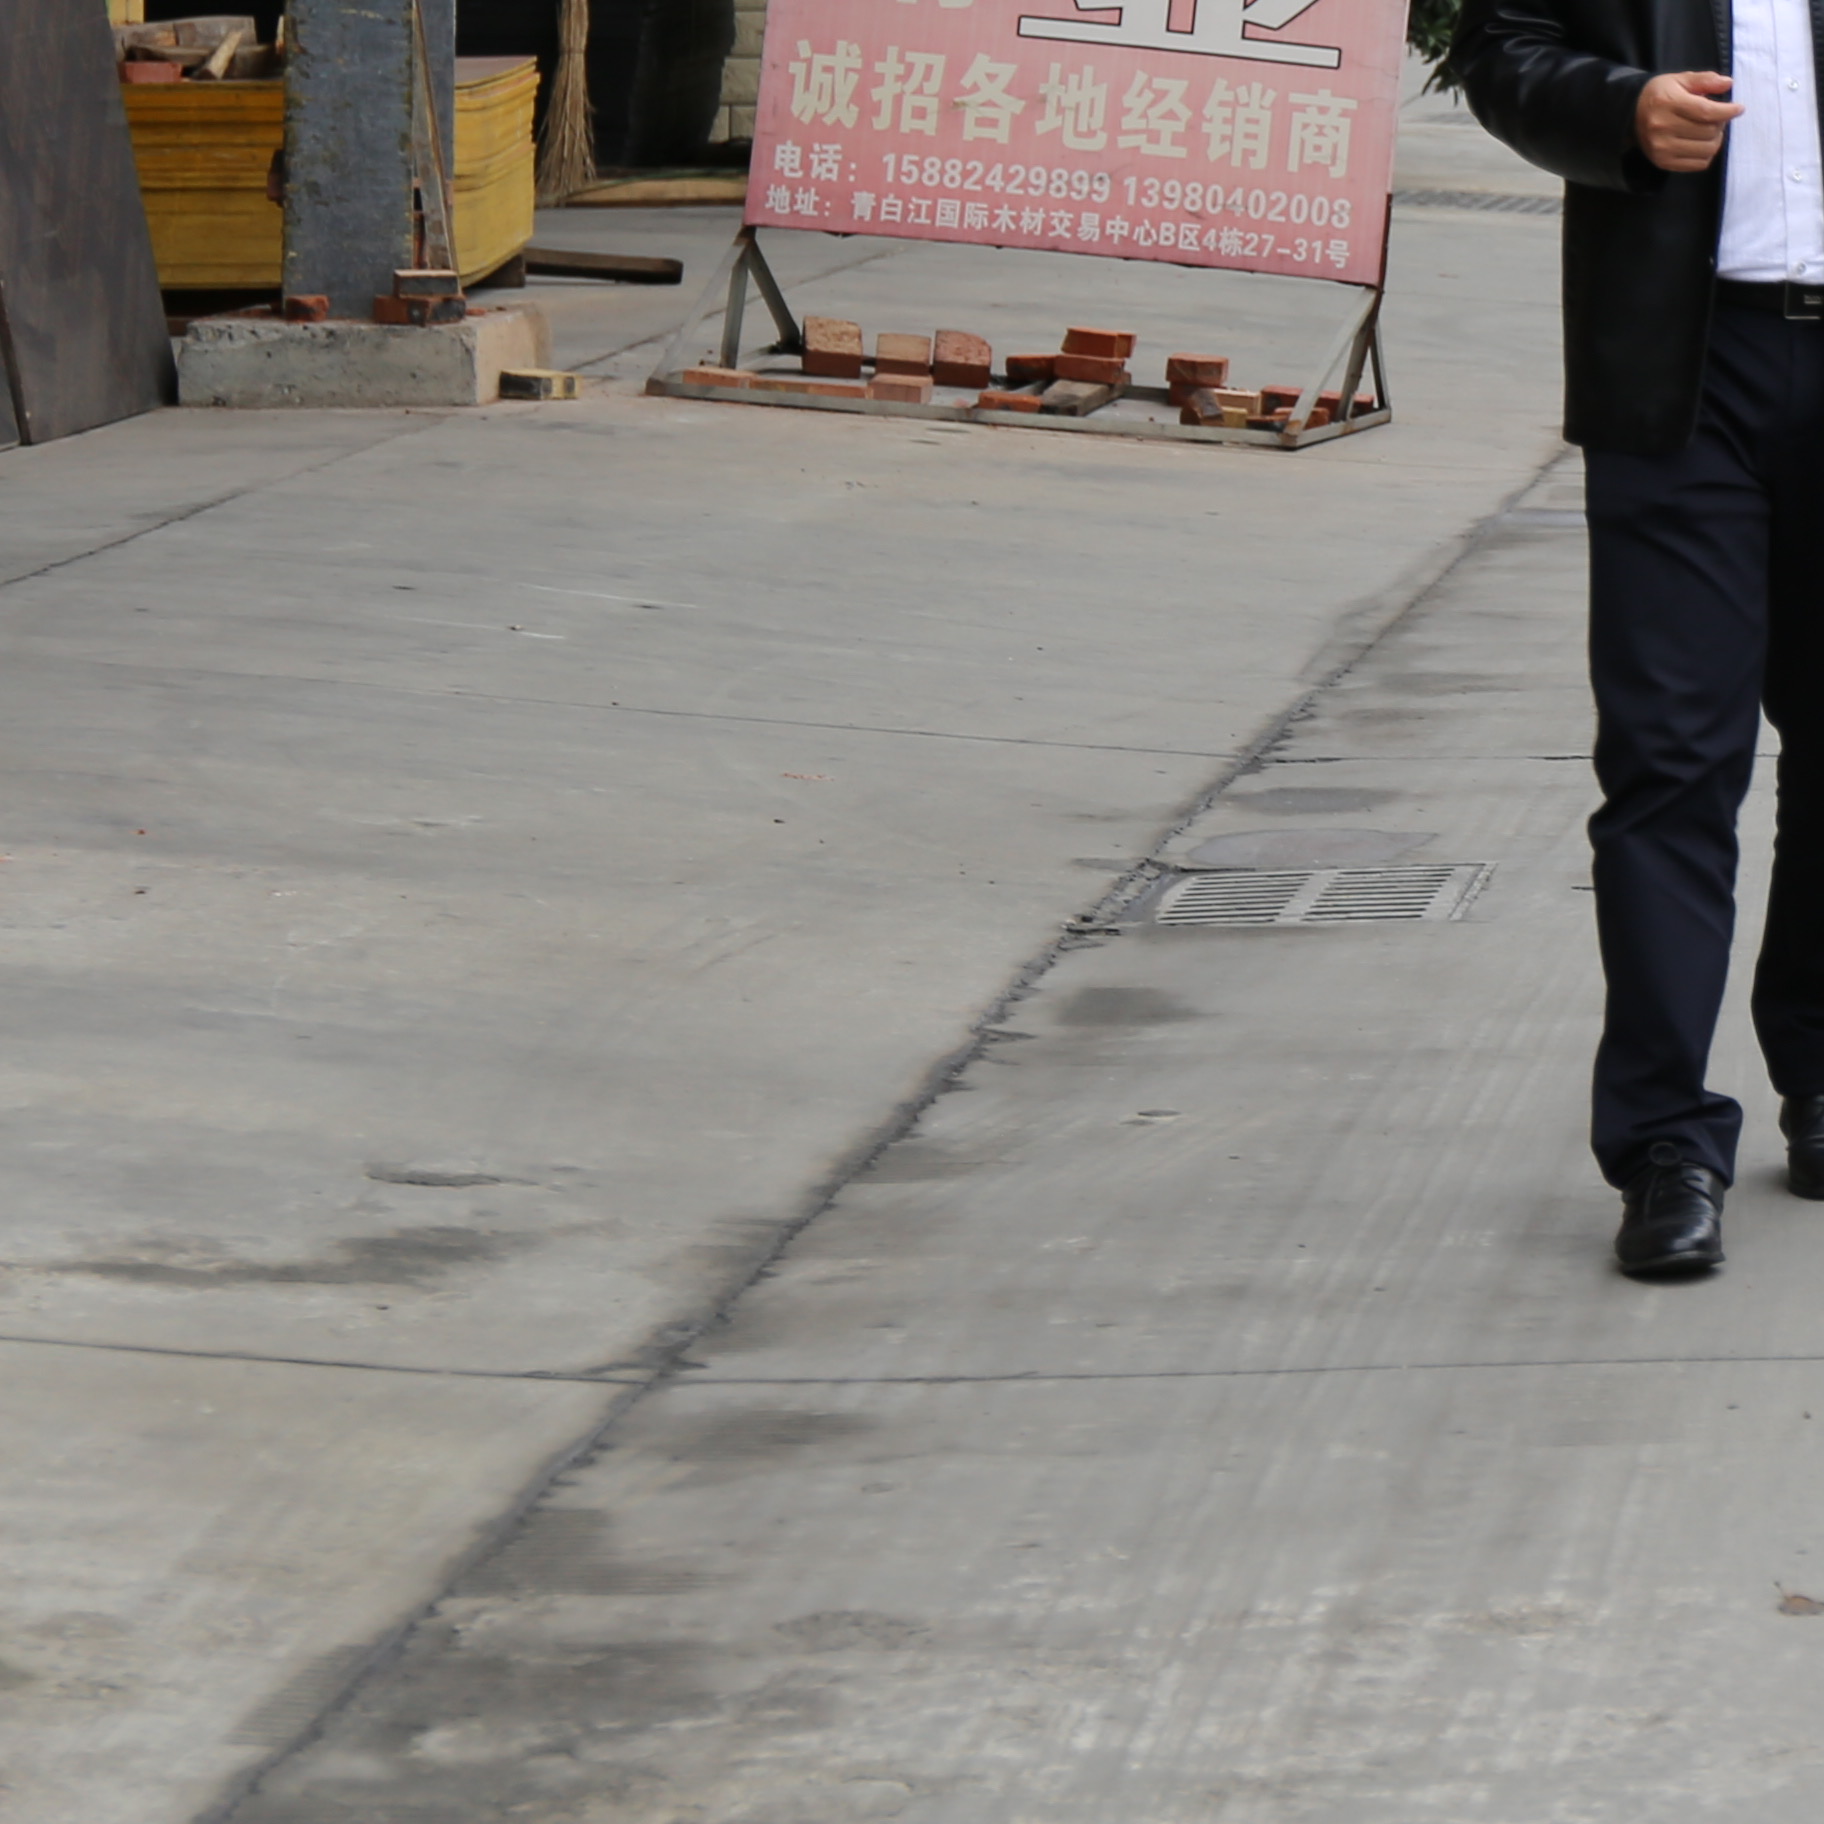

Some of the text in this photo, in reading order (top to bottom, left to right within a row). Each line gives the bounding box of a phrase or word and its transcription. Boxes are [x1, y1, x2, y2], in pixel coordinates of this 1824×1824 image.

[788, 39, 1359, 179] 诚招各地经销商
[881, 152, 1113, 205] 15882429899
[1123, 176, 1353, 230] 13980402008
